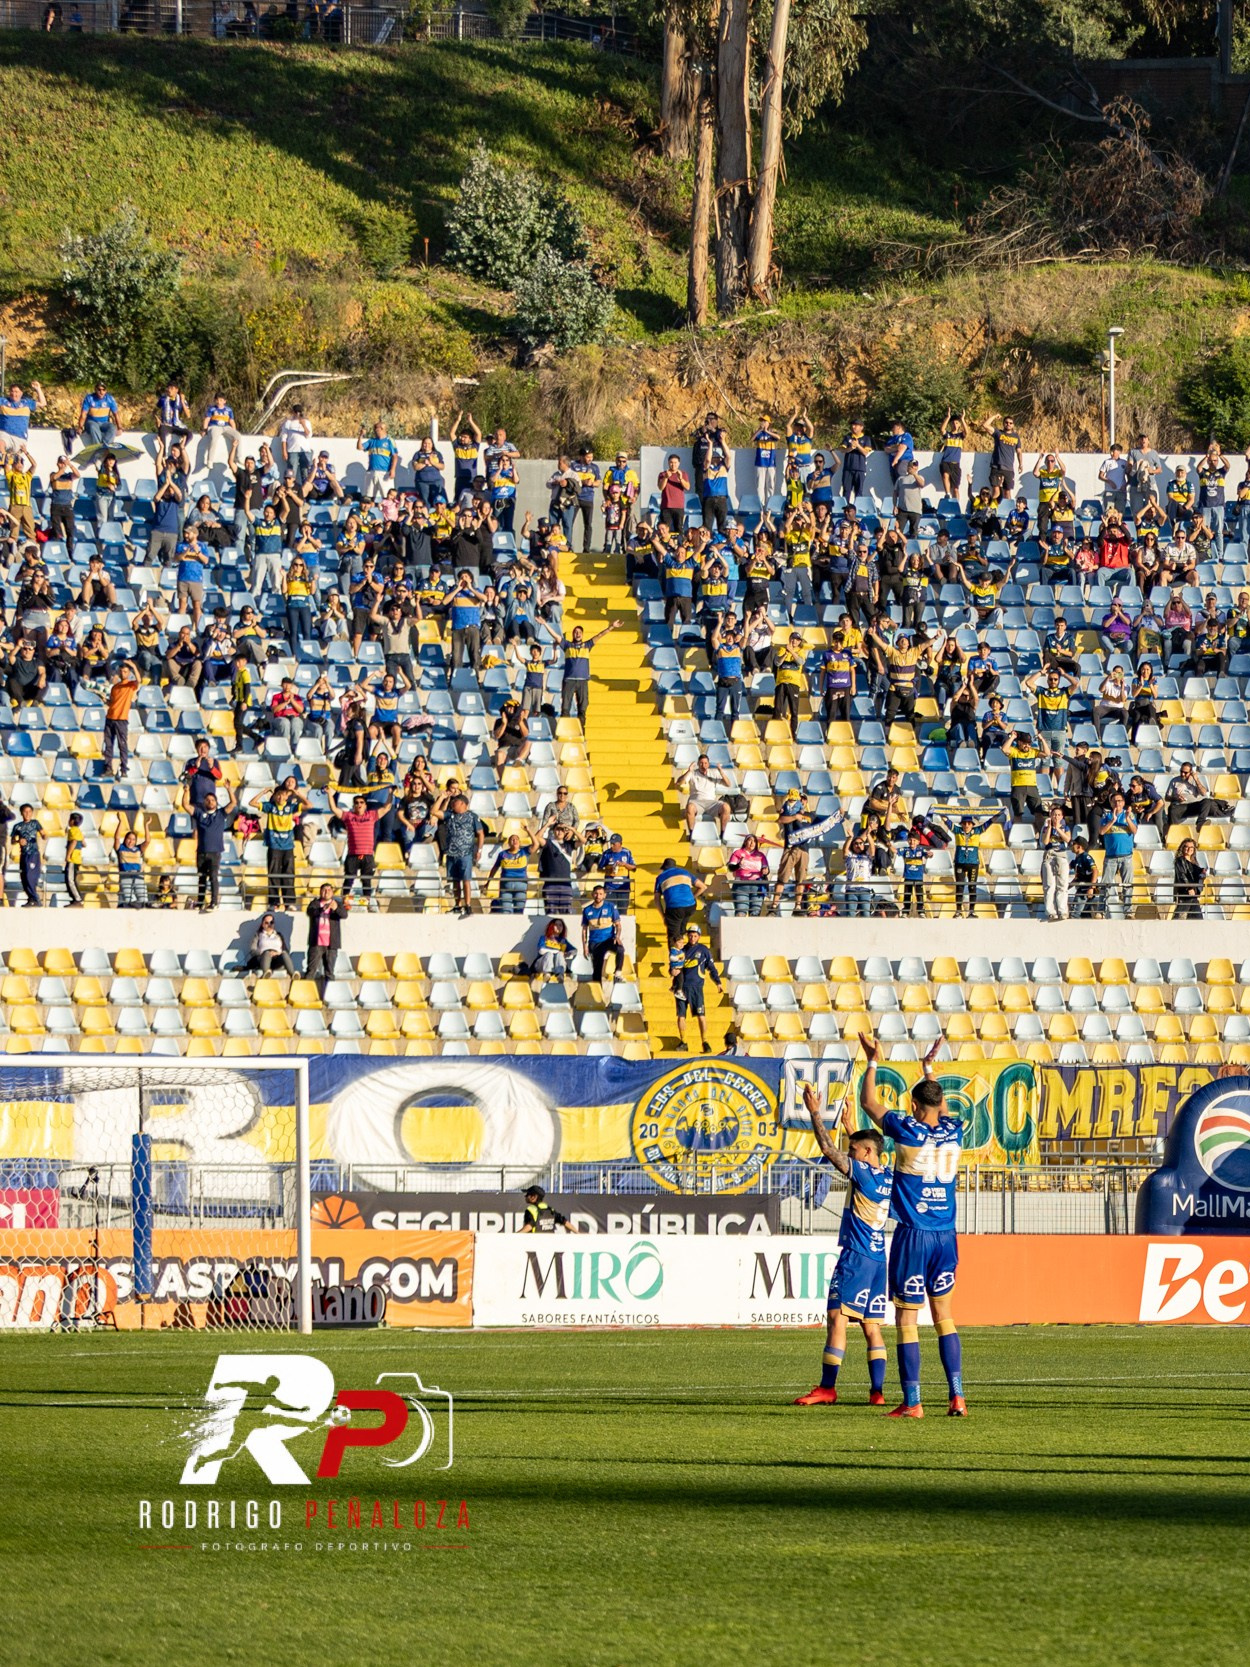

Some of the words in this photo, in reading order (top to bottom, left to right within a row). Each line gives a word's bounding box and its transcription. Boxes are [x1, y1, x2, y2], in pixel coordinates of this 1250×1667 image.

[650, 1085, 675, 1112] LOS
[683, 1069, 712, 1085] DEL
[724, 1072, 768, 1111] CERRO
[639, 1123, 659, 1139] 20
[758, 1121, 778, 1137] 03
[913, 1141, 962, 1184] 40
[521, 1313, 576, 1324] SABORES
[580, 1310, 660, 1324] FANTÁSTICOS
[751, 1313, 803, 1323] SABORES
